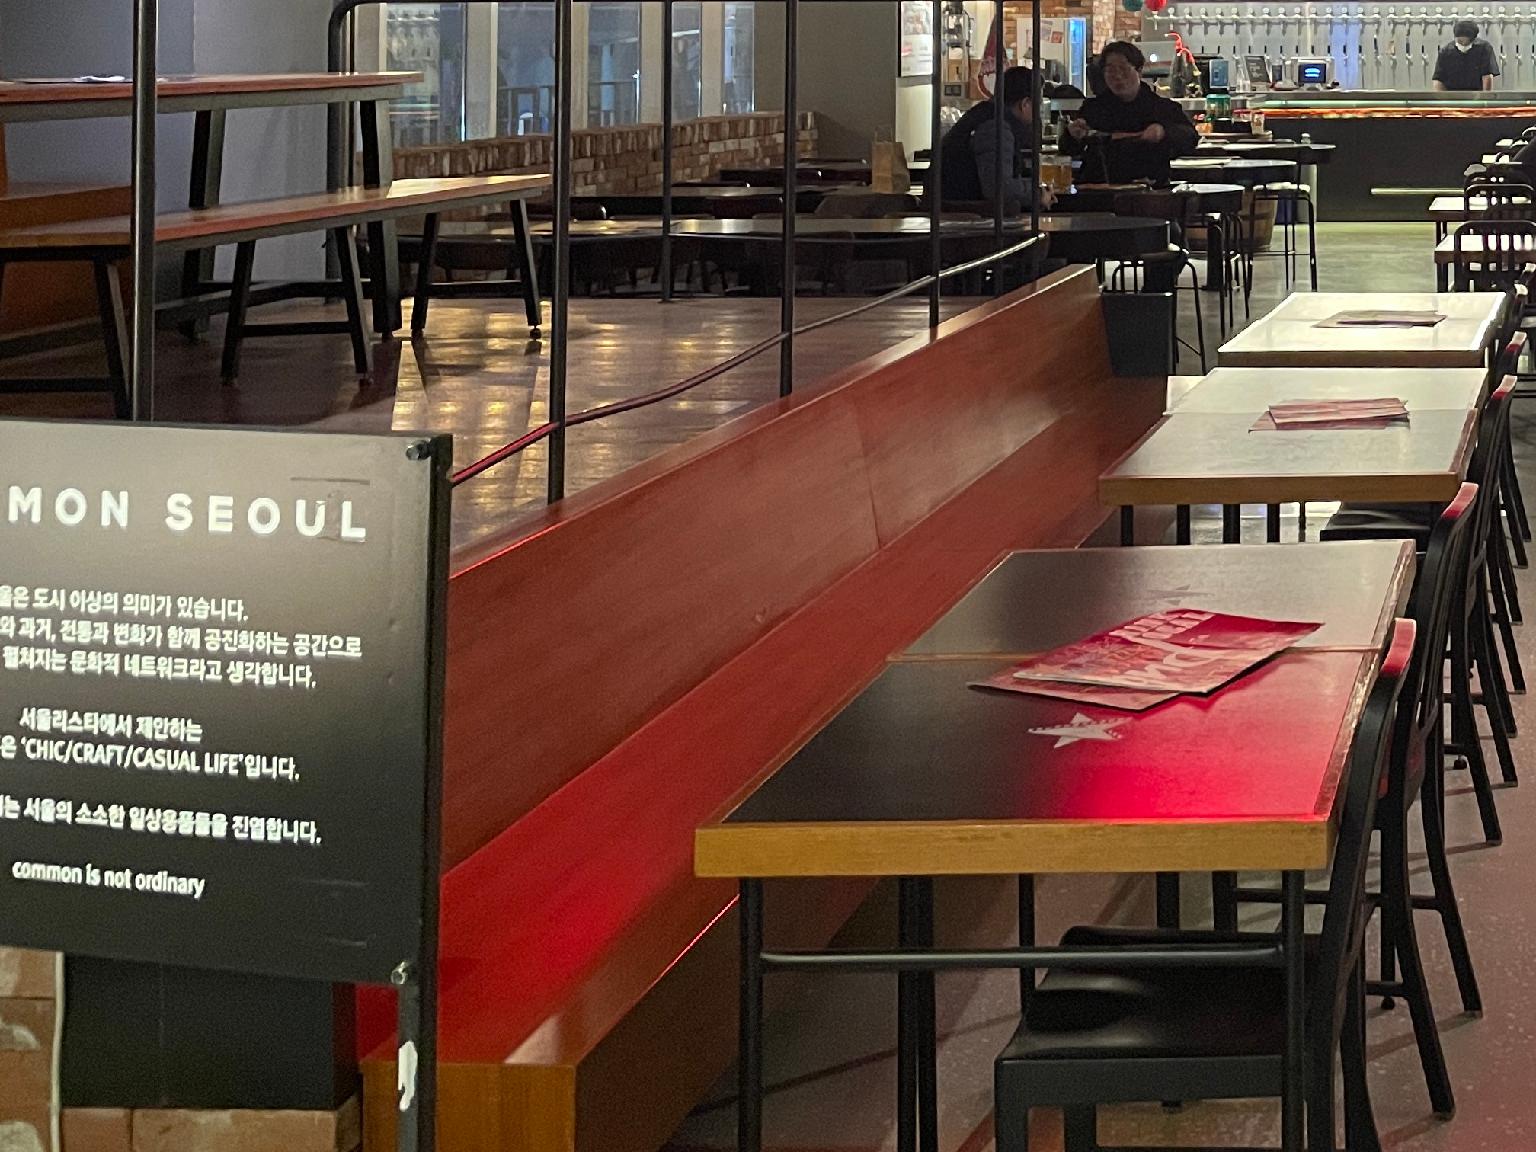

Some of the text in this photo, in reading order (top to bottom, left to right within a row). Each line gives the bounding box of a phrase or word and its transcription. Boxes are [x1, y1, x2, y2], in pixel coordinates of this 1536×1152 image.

[164, 492, 367, 540] SEOUL
[33, 587, 66, 612] 도시
[69, 589, 119, 615] 이상의
[122, 592, 172, 617] 의미가
[177, 597, 250, 622] 있습니다.
[19, 617, 56, 643] 과거,
[60, 619, 110, 645] 전통과
[113, 622, 163, 648] 변화가
[167, 625, 201, 650] 함께
[204, 628, 290, 656] 공진화하는
[293, 633, 362, 659] 공간으로
[3, 645, 317, 690] 펼쳐지는 문화적 네트워크라고 생각합니다.
[19, 706, 203, 743] 서울리스타에서 제안하는
[24, 797, 73, 825] 서울의
[75, 802, 126, 830] 소소한
[232, 815, 323, 845] 진열합니다.
[12, 861, 206, 900] common is not ordinary
